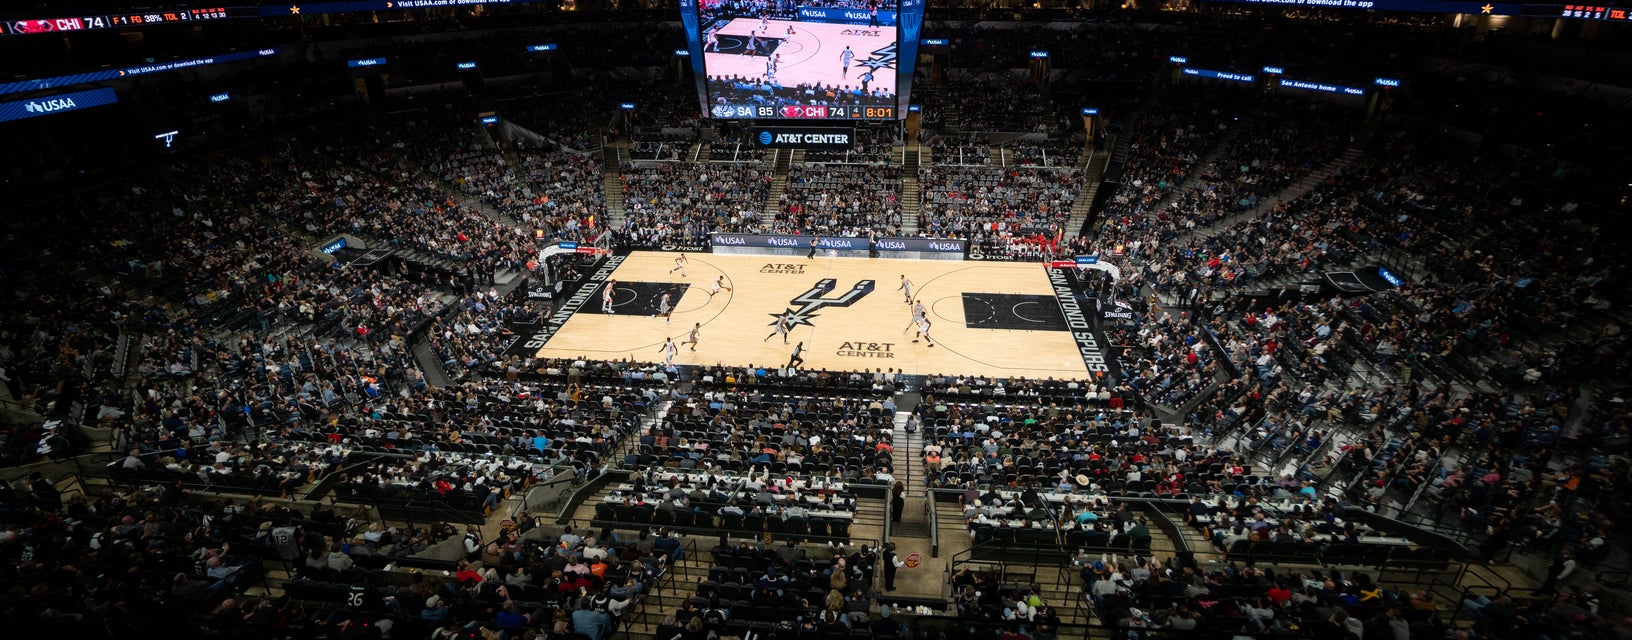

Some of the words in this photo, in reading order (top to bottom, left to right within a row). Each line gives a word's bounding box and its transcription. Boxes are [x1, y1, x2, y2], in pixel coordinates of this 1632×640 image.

[130, 15, 142, 23] FG
[144, 14, 163, 23] 38%
[164, 13, 179, 21] TOL
[180, 12, 187, 20] 2
[1610, 10, 1626, 19] TOL
[56, 18, 81, 30] CHI
[84, 17, 104, 28] 74
[140, 64, 167, 73] USAA.com
[174, 60, 196, 68] download
[1293, 81, 1318, 89] Antonio
[1318, 84, 1337, 92] home
[42, 98, 76, 112] USAA
[737, 107, 752, 117] SA
[758, 107, 773, 117] 85
[805, 107, 824, 117] CHI
[829, 107, 845, 117] 74
[866, 107, 893, 117] 8:01
[775, 134, 803, 144] AT&T
[804, 134, 849, 145] CENTER
[725, 237, 746, 246] USAA
[777, 238, 798, 247] USAA
[831, 239, 852, 248] USAA
[885, 240, 906, 249] USAA
[940, 241, 961, 251] USAA
[1050, 268, 1068, 285] SAN
[549, 283, 600, 327] ANTONIO
[591, 256, 625, 281] SPURS
[1053, 284, 1089, 329] ANTONIO
[1104, 311, 1132, 319] SPALDING
[838, 341, 896, 352] AT&T
[836, 350, 895, 359] CENTER
[1076, 332, 1109, 373] SPURS
[275, 535, 288, 544] 12
[347, 592, 364, 606] 26
